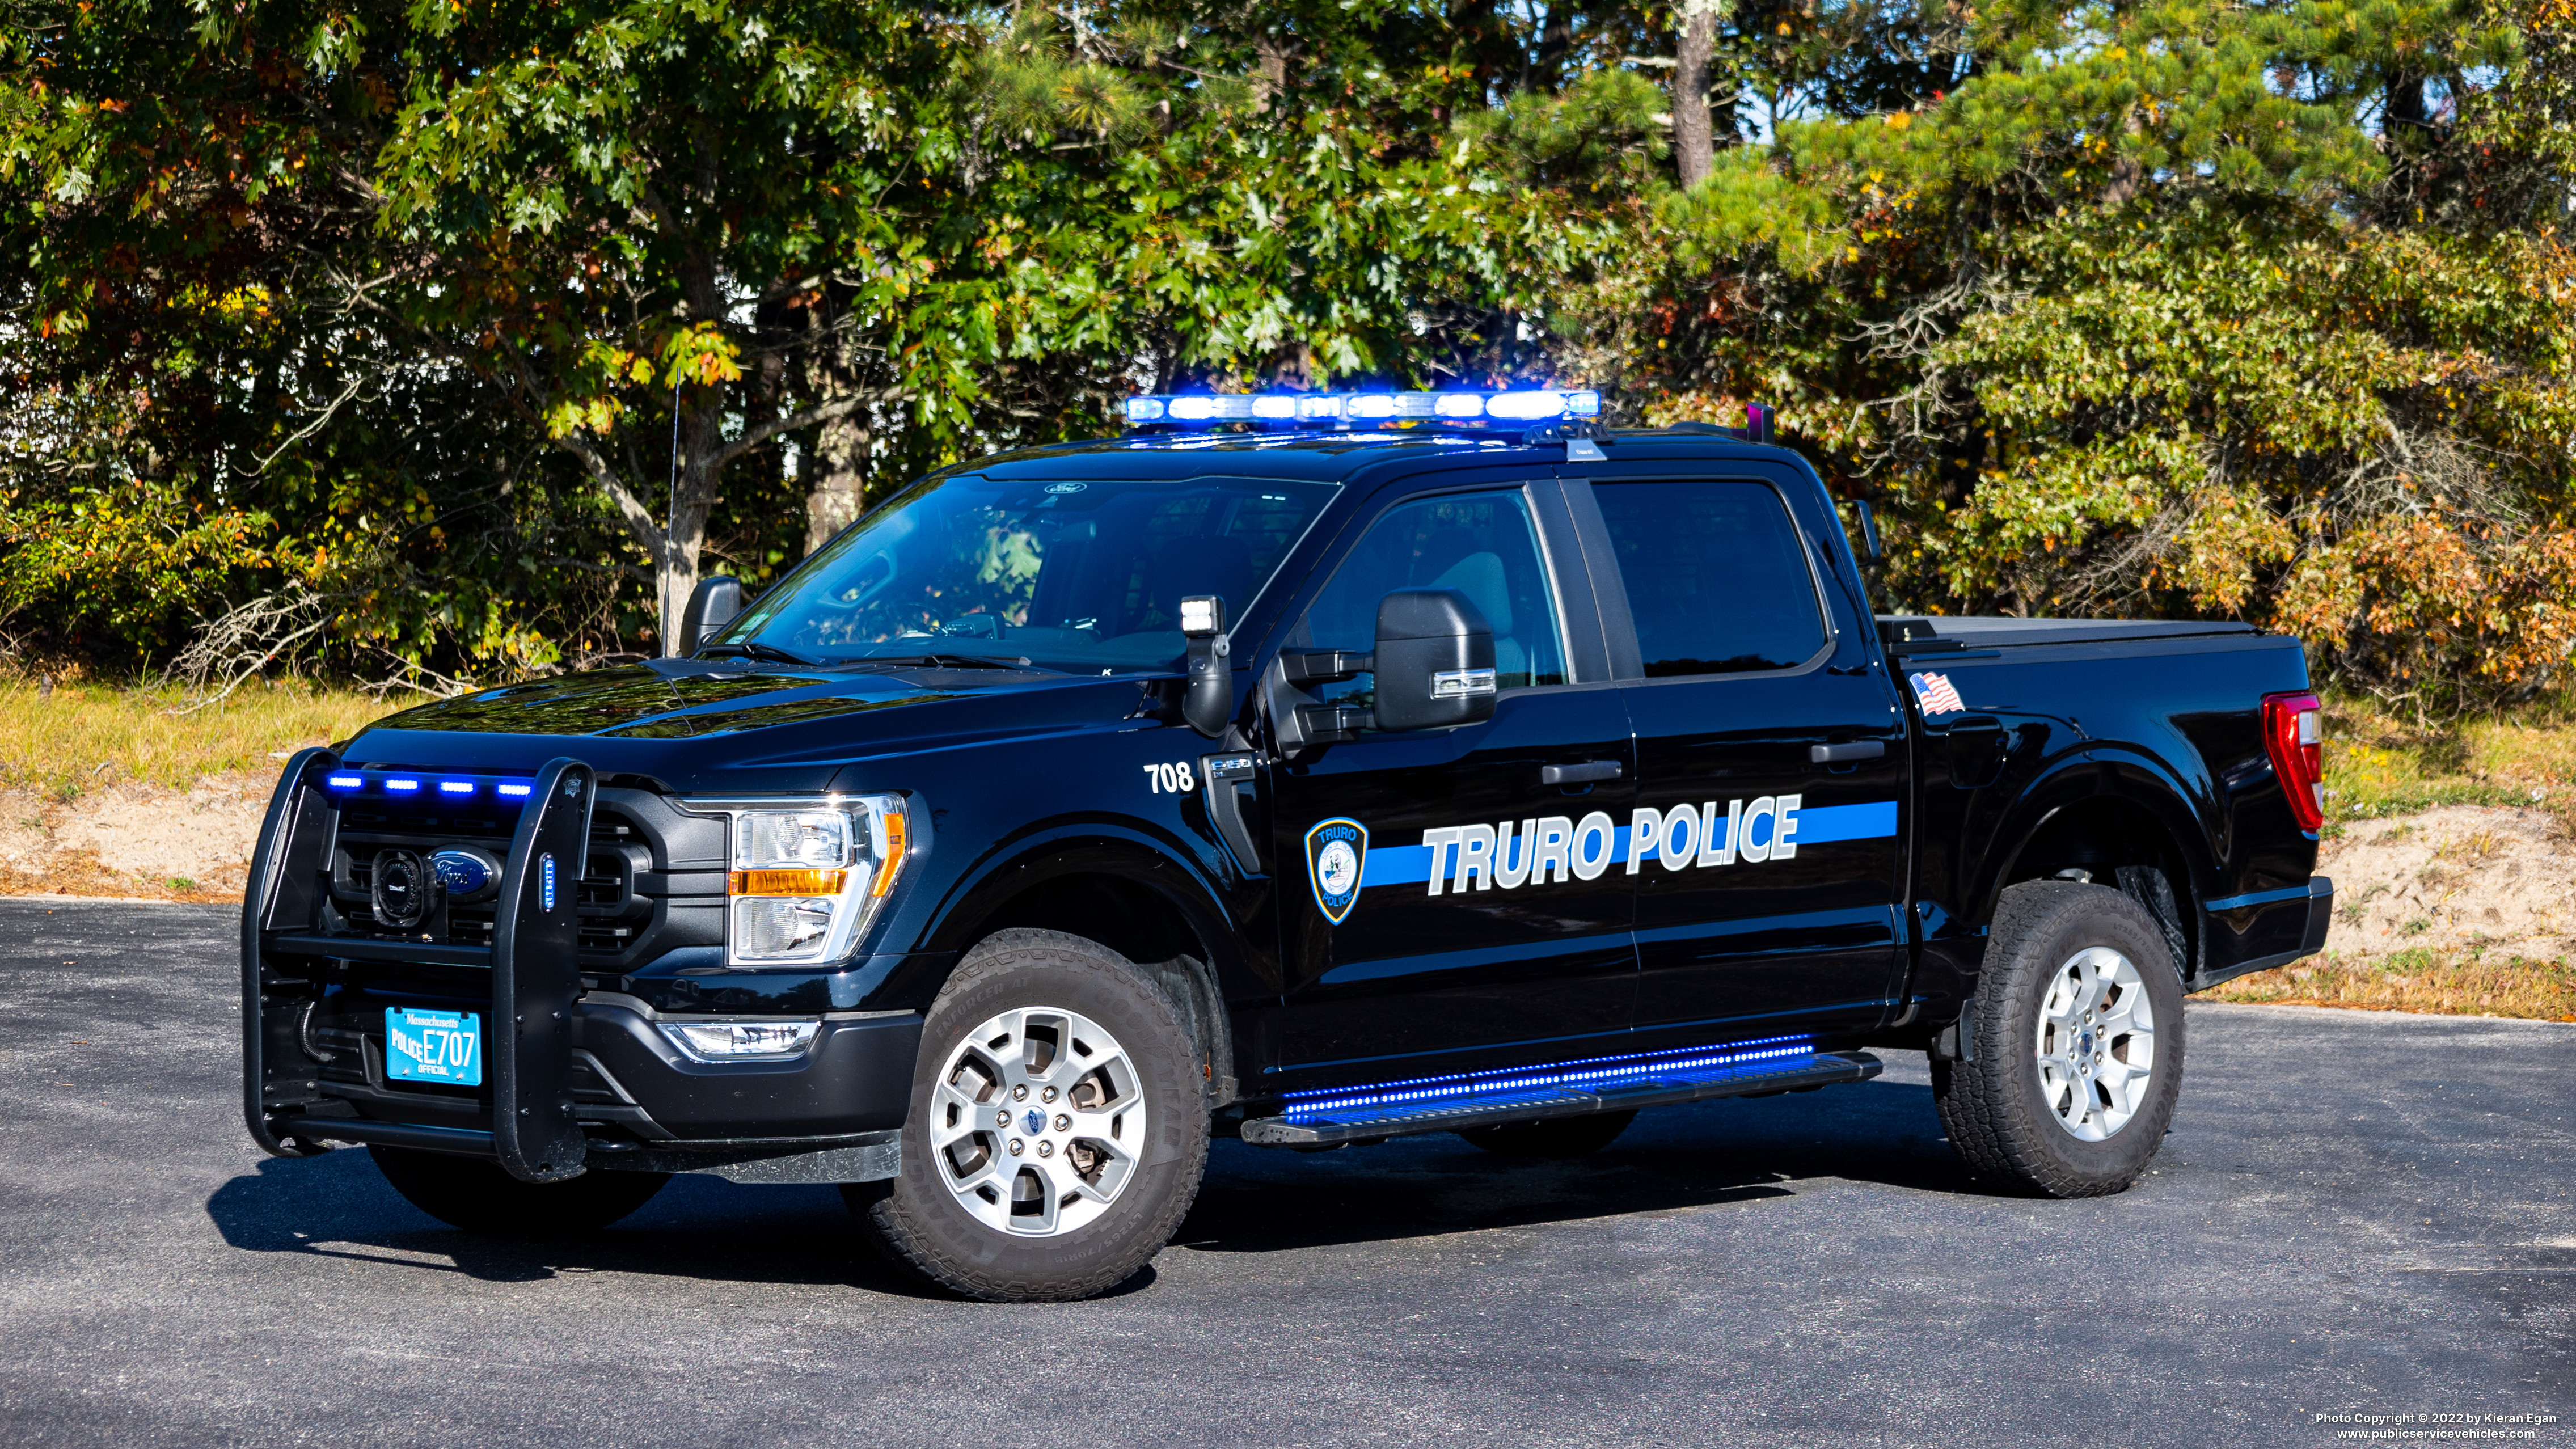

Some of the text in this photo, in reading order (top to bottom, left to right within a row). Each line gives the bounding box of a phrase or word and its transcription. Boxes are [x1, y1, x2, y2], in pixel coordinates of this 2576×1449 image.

[1143, 762, 1194, 793] 708
[1211, 759, 1251, 770] F-150
[1317, 826, 1357, 843] TRURO
[1422, 793, 1802, 896] TRURO POLICE
[436, 860, 472, 885] Ford
[1321, 890, 1354, 907] POLICE
[407, 1013, 459, 1028] Massachusetts
[936, 982, 1004, 1038] ENFORCER
[391, 1028, 475, 1067] POLICE E707
[417, 1064, 450, 1076] OFFICIAL
[1095, 987, 1182, 1146] GOODYEAR
[1029, 1113, 1038, 1129] Ford
[901, 1106, 985, 1257] WRANGLER
[1054, 1212, 1143, 1264] LT265/70R18
